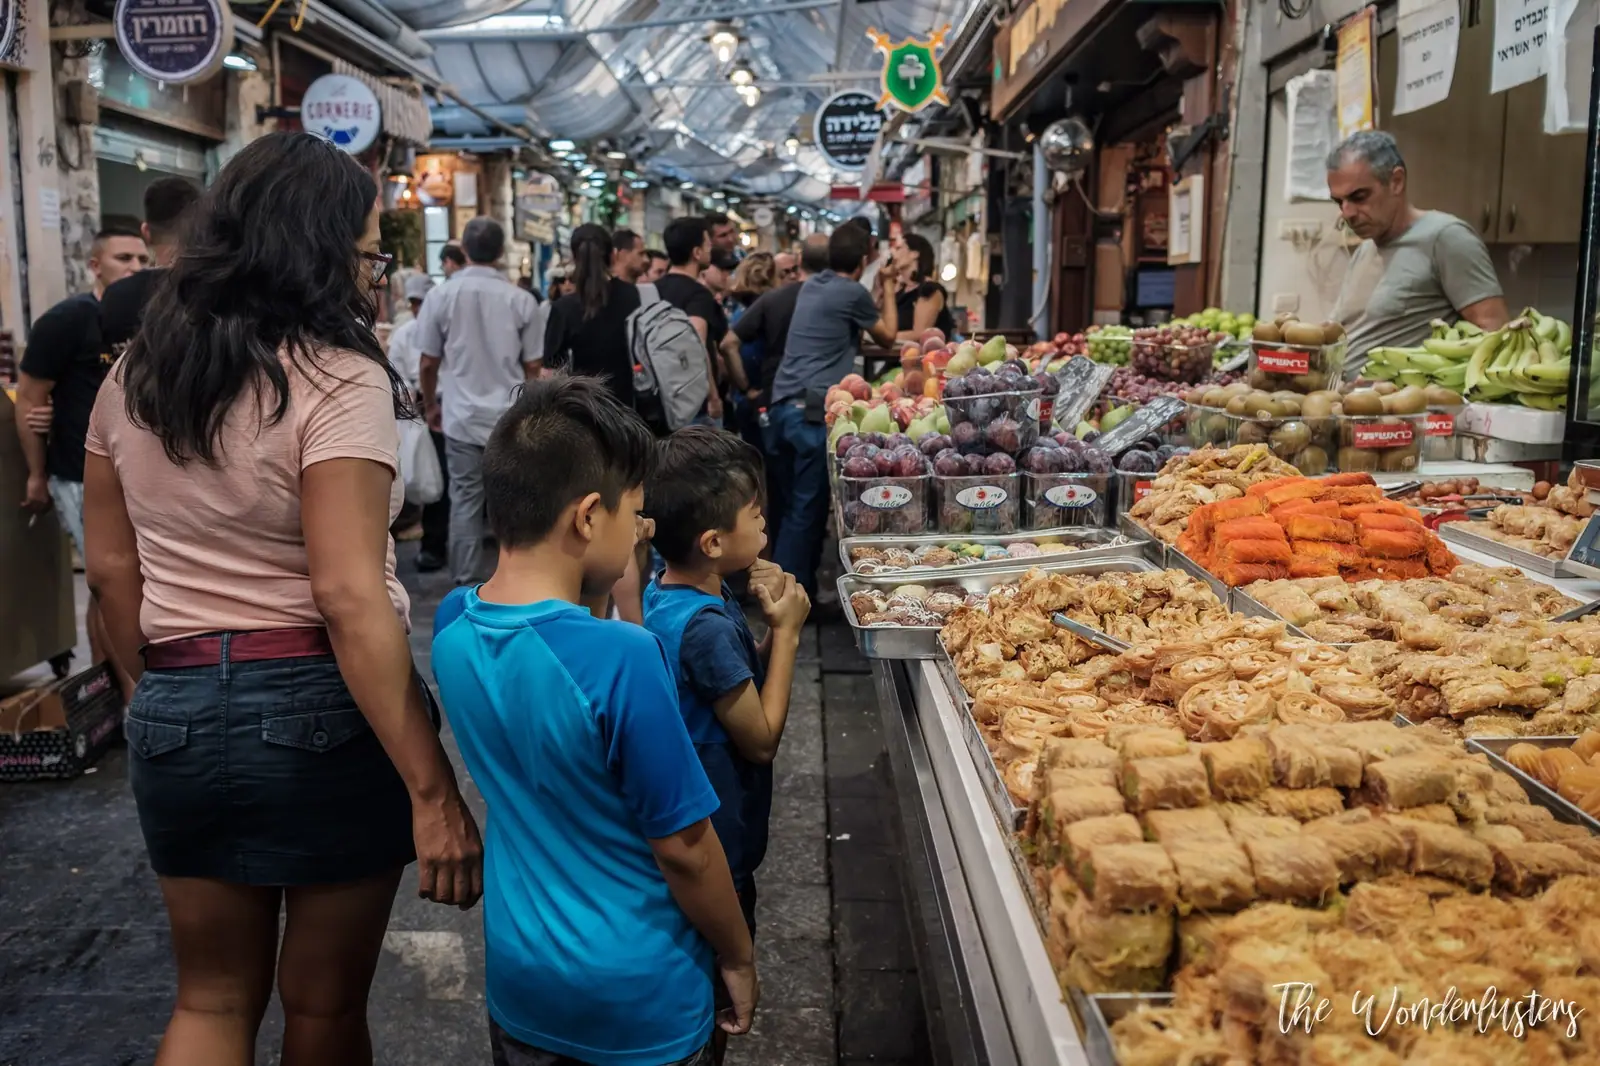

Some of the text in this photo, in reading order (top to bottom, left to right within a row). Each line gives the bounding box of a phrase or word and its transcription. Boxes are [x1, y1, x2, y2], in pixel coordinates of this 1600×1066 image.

[132, 14, 207, 42] רוזמרין
[1498, 40, 1530, 62] אשראי
[307, 102, 373, 122] CORNERIE
[825, 111, 881, 132] גלידה
